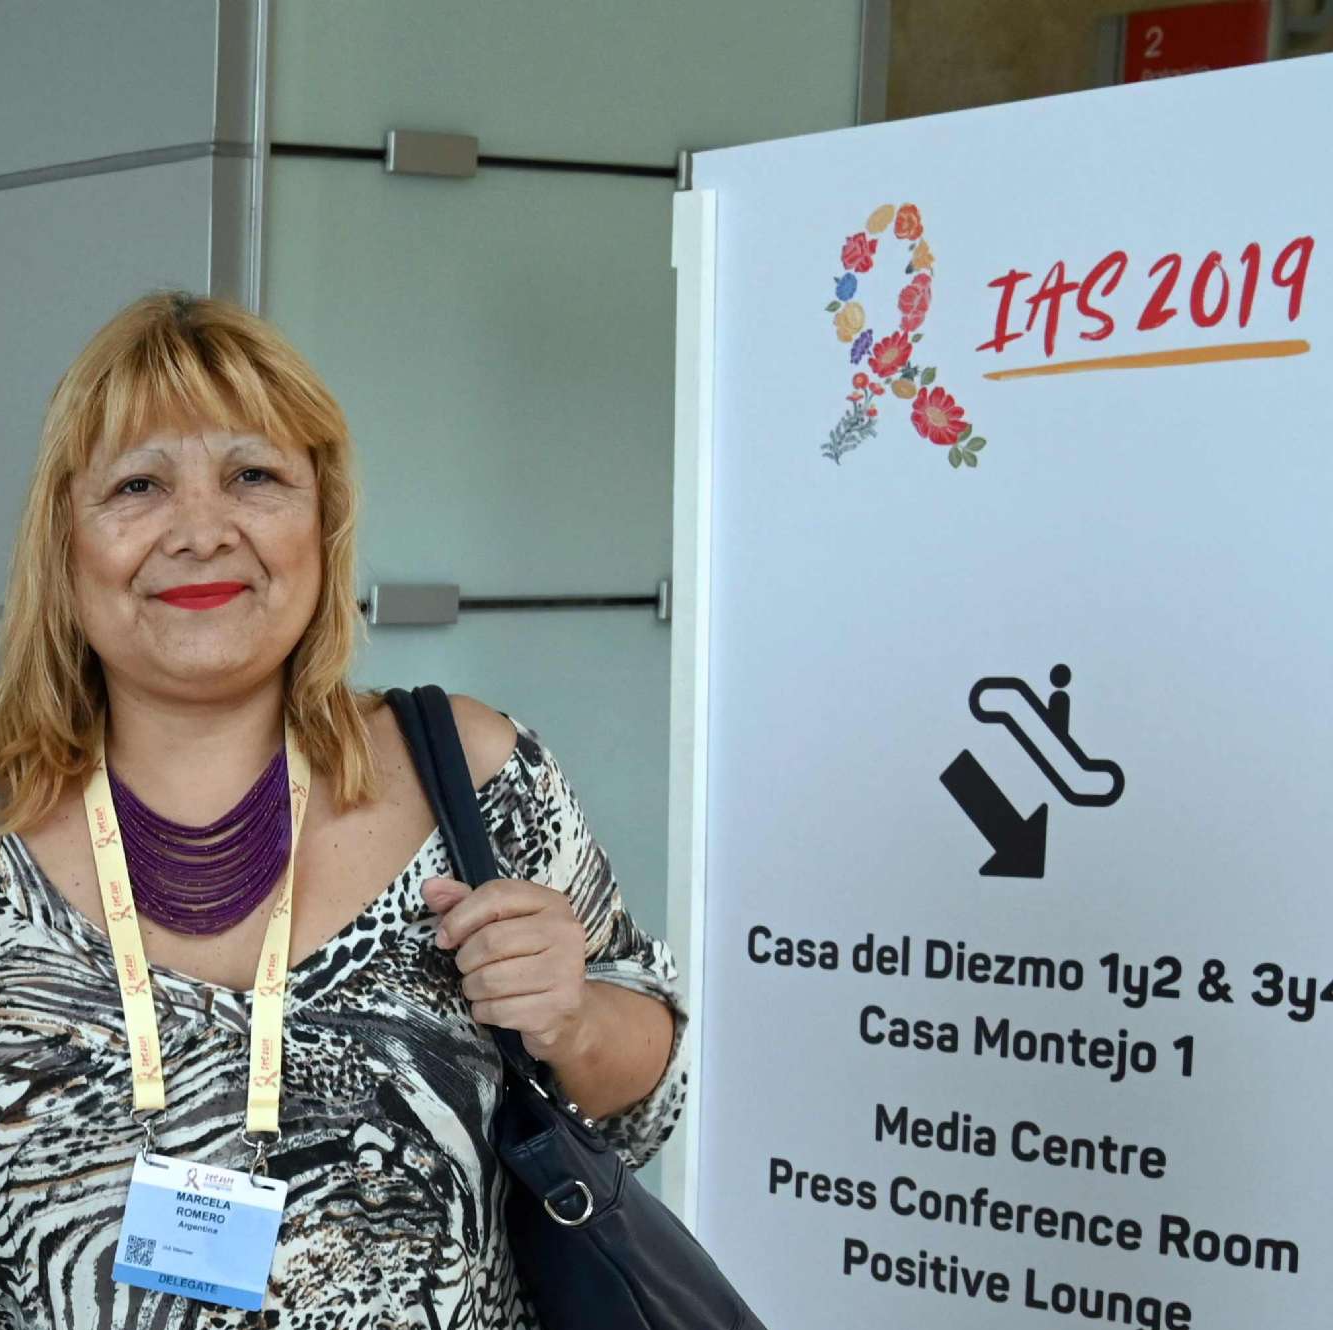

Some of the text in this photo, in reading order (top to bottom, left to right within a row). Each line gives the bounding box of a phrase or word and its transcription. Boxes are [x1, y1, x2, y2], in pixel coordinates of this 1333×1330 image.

[1144, 26, 1164, 58] 2
[747, 925, 839, 970] Casa
[852, 933, 911, 976] del
[925, 939, 1084, 991] Diezmo
[1099, 952, 1182, 1009] 1y2
[1198, 958, 1234, 1004] &
[859, 1005, 1194, 1083] Casa Montejo 1
[875, 1103, 1167, 1179] Media Centre
[176, 1207, 225, 1224] ROMERO
[177, 1192, 230, 1210] MARCELA
[769, 1157, 1299, 1274] Press Conference Room
[158, 1273, 218, 1294] DELEGATE
[843, 1237, 1010, 1303] Positive
